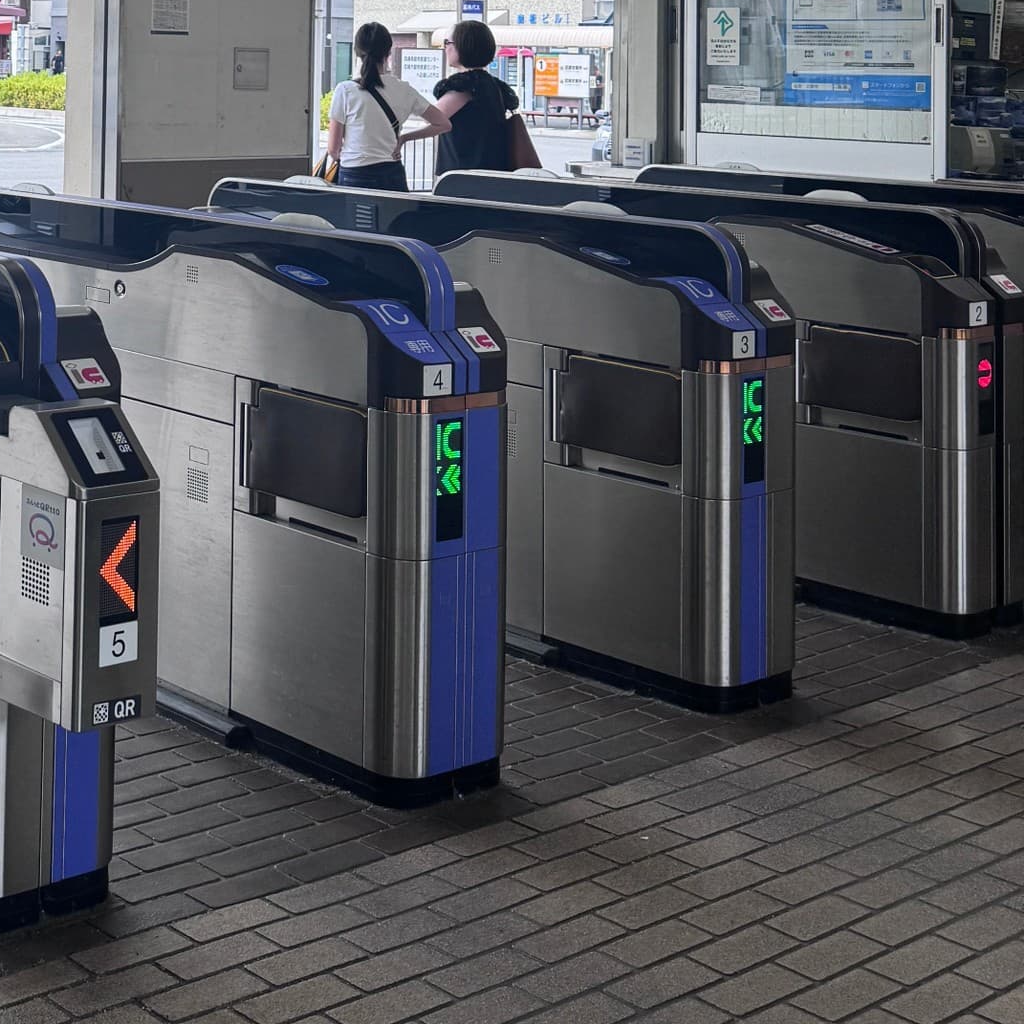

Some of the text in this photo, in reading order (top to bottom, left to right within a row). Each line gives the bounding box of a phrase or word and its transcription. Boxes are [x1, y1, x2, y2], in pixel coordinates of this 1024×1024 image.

[678, 279, 714, 299] IC
[368, 303, 410, 326] IC
[975, 305, 983, 322] 2
[740, 335, 749, 354] 3
[432, 369, 444, 391] 4
[743, 380, 763, 414] IC
[118, 444, 133, 453] QR
[436, 421, 462, 461] IC
[111, 629, 126, 658] 5
[114, 698, 136, 718] QR
